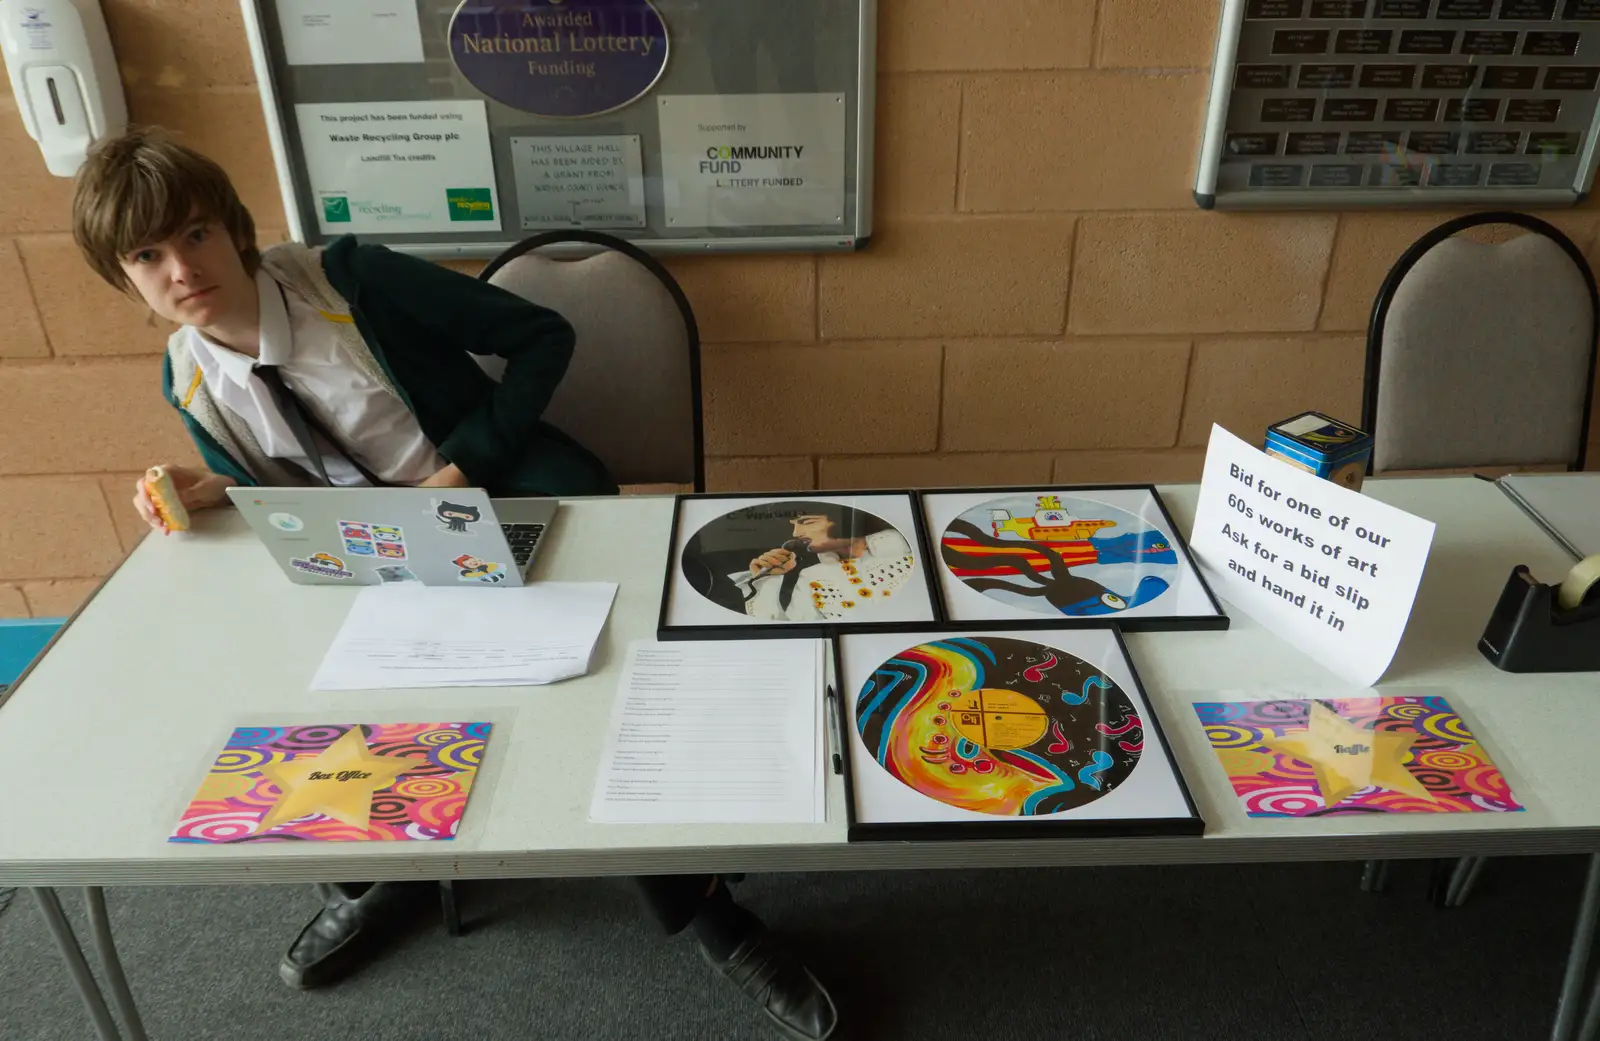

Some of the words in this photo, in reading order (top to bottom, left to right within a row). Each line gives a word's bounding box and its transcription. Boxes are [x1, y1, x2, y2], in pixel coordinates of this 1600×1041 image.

[522, 12, 593, 27] Awarded
[462, 32, 561, 54] National
[570, 32, 655, 56] Lottery
[528, 60, 596, 77] Funding
[320, 114, 337, 122] This
[339, 113, 368, 123] project
[370, 113, 385, 121] has
[387, 112, 407, 121] been
[409, 112, 438, 121] funded
[439, 113, 463, 122] using
[698, 124, 736, 132] Supported
[737, 124, 746, 133] by
[329, 133, 360, 142] Waste
[362, 133, 410, 143] Recycling
[413, 132, 442, 142] Group
[445, 132, 460, 142] plc
[530, 144, 552, 153] THIS
[555, 144, 593, 153] VILLAGE
[597, 144, 620, 152] HALL
[706, 145, 804, 160] COMMUNITY
[361, 154, 390, 163] Landfill
[392, 154, 406, 162] Tax
[408, 153, 436, 162] credits
[530, 158, 549, 167] HAS
[553, 157, 577, 167] BEEN
[581, 157, 609, 166] AIDED
[613, 156, 624, 166] BY
[543, 170, 550, 179] A
[553, 170, 584, 179] GRANT
[588, 169, 614, 179] FROM
[699, 161, 742, 174] FUND
[762, 178, 803, 187] FUNDED
[1229, 462, 1253, 488] Bid
[1258, 479, 1282, 502] for
[1286, 497, 1322, 520] one
[1328, 513, 1350, 531] of
[1355, 525, 1391, 549] our
[1227, 493, 1254, 519] 60s
[1259, 514, 1315, 549] works
[1321, 542, 1342, 560] of
[1347, 554, 1379, 578] art
[1221, 523, 1249, 549] Ask
[1254, 541, 1279, 564] for
[1283, 559, 1295, 572] a
[1300, 563, 1330, 589] bid
[1335, 582, 1370, 611] slip
[1228, 557, 1257, 583] and
[1262, 575, 1306, 608] hand
[1309, 600, 1325, 620] it
[1328, 611, 1345, 632] in
[1334, 744, 1370, 755] Raffle
[308, 770, 334, 781] Box
[334, 770, 372, 783] Office
